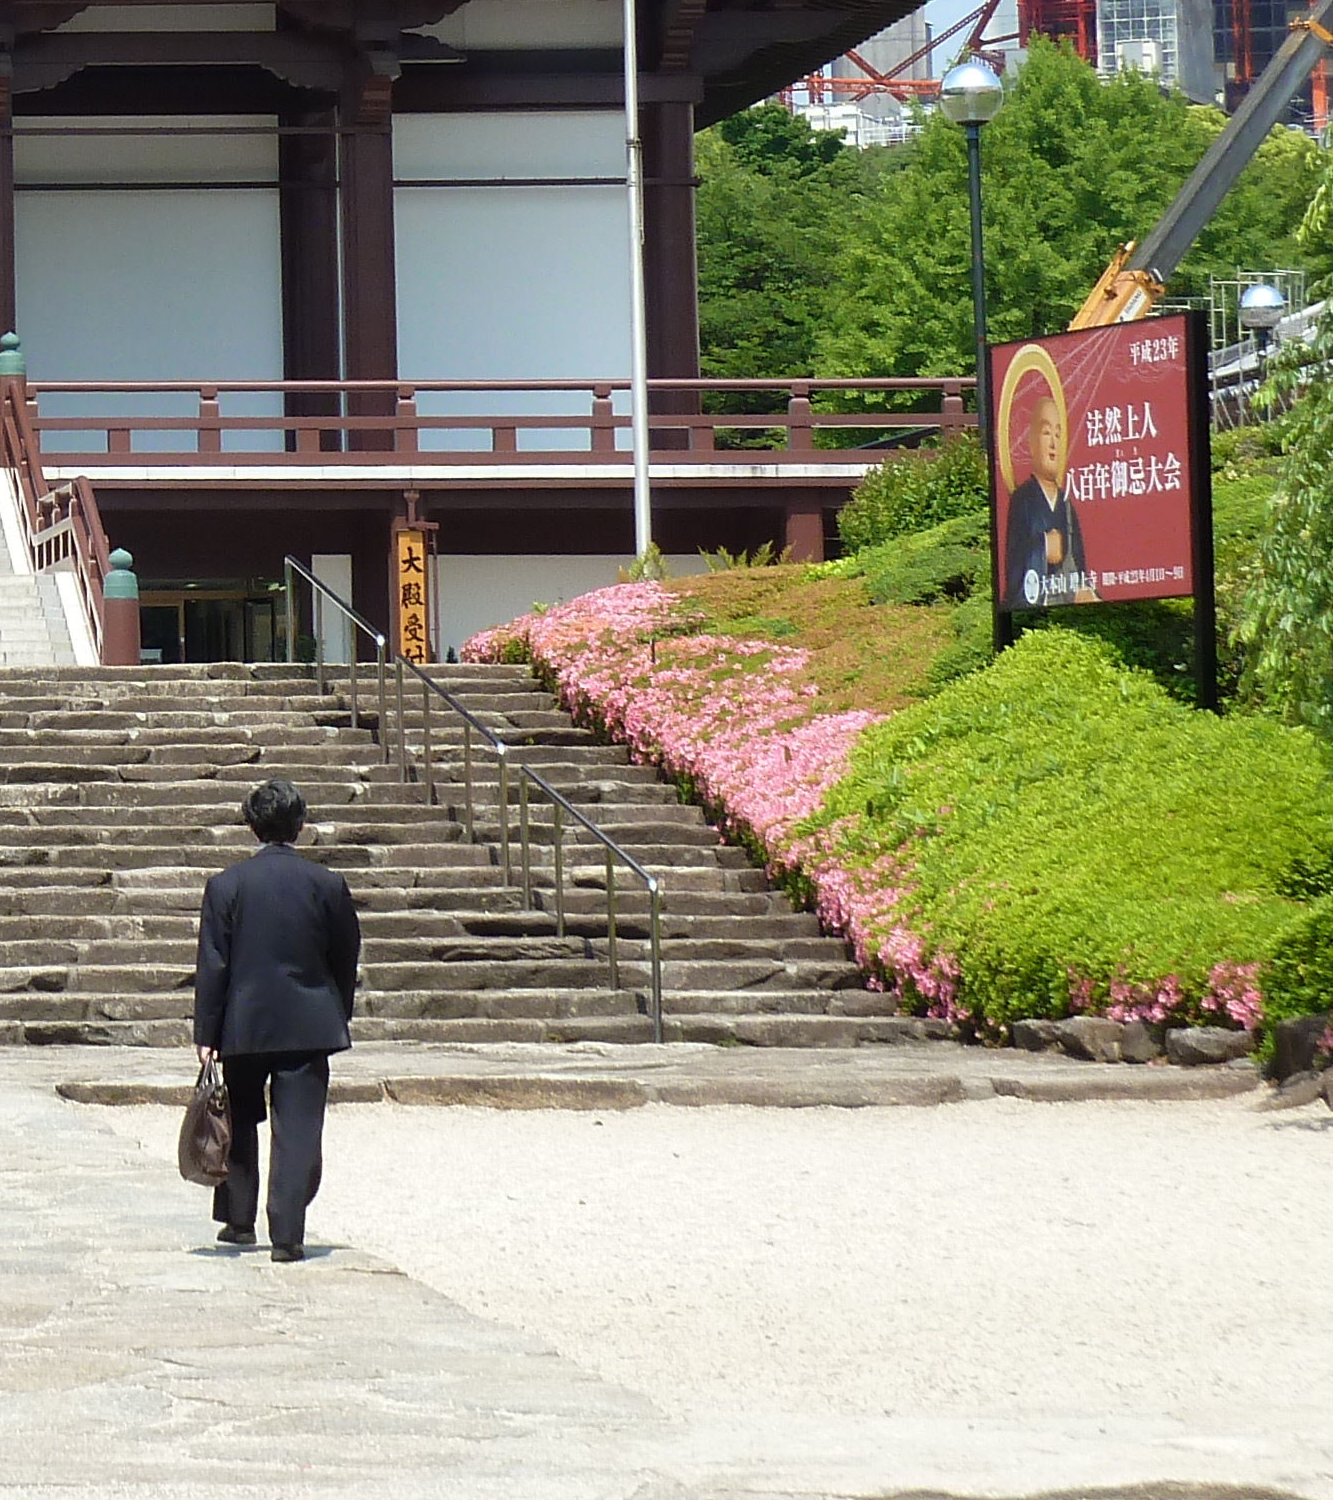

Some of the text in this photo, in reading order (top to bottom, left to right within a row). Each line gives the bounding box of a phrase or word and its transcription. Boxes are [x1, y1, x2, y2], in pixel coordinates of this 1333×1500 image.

[1129, 336, 1179, 366] 平成23年
[1086, 401, 1157, 447] 法然上人
[1064, 452, 1181, 502] 八百年御忌大会
[401, 547, 425, 663] 大殿受付
[1040, 574, 1067, 595] 大本山
